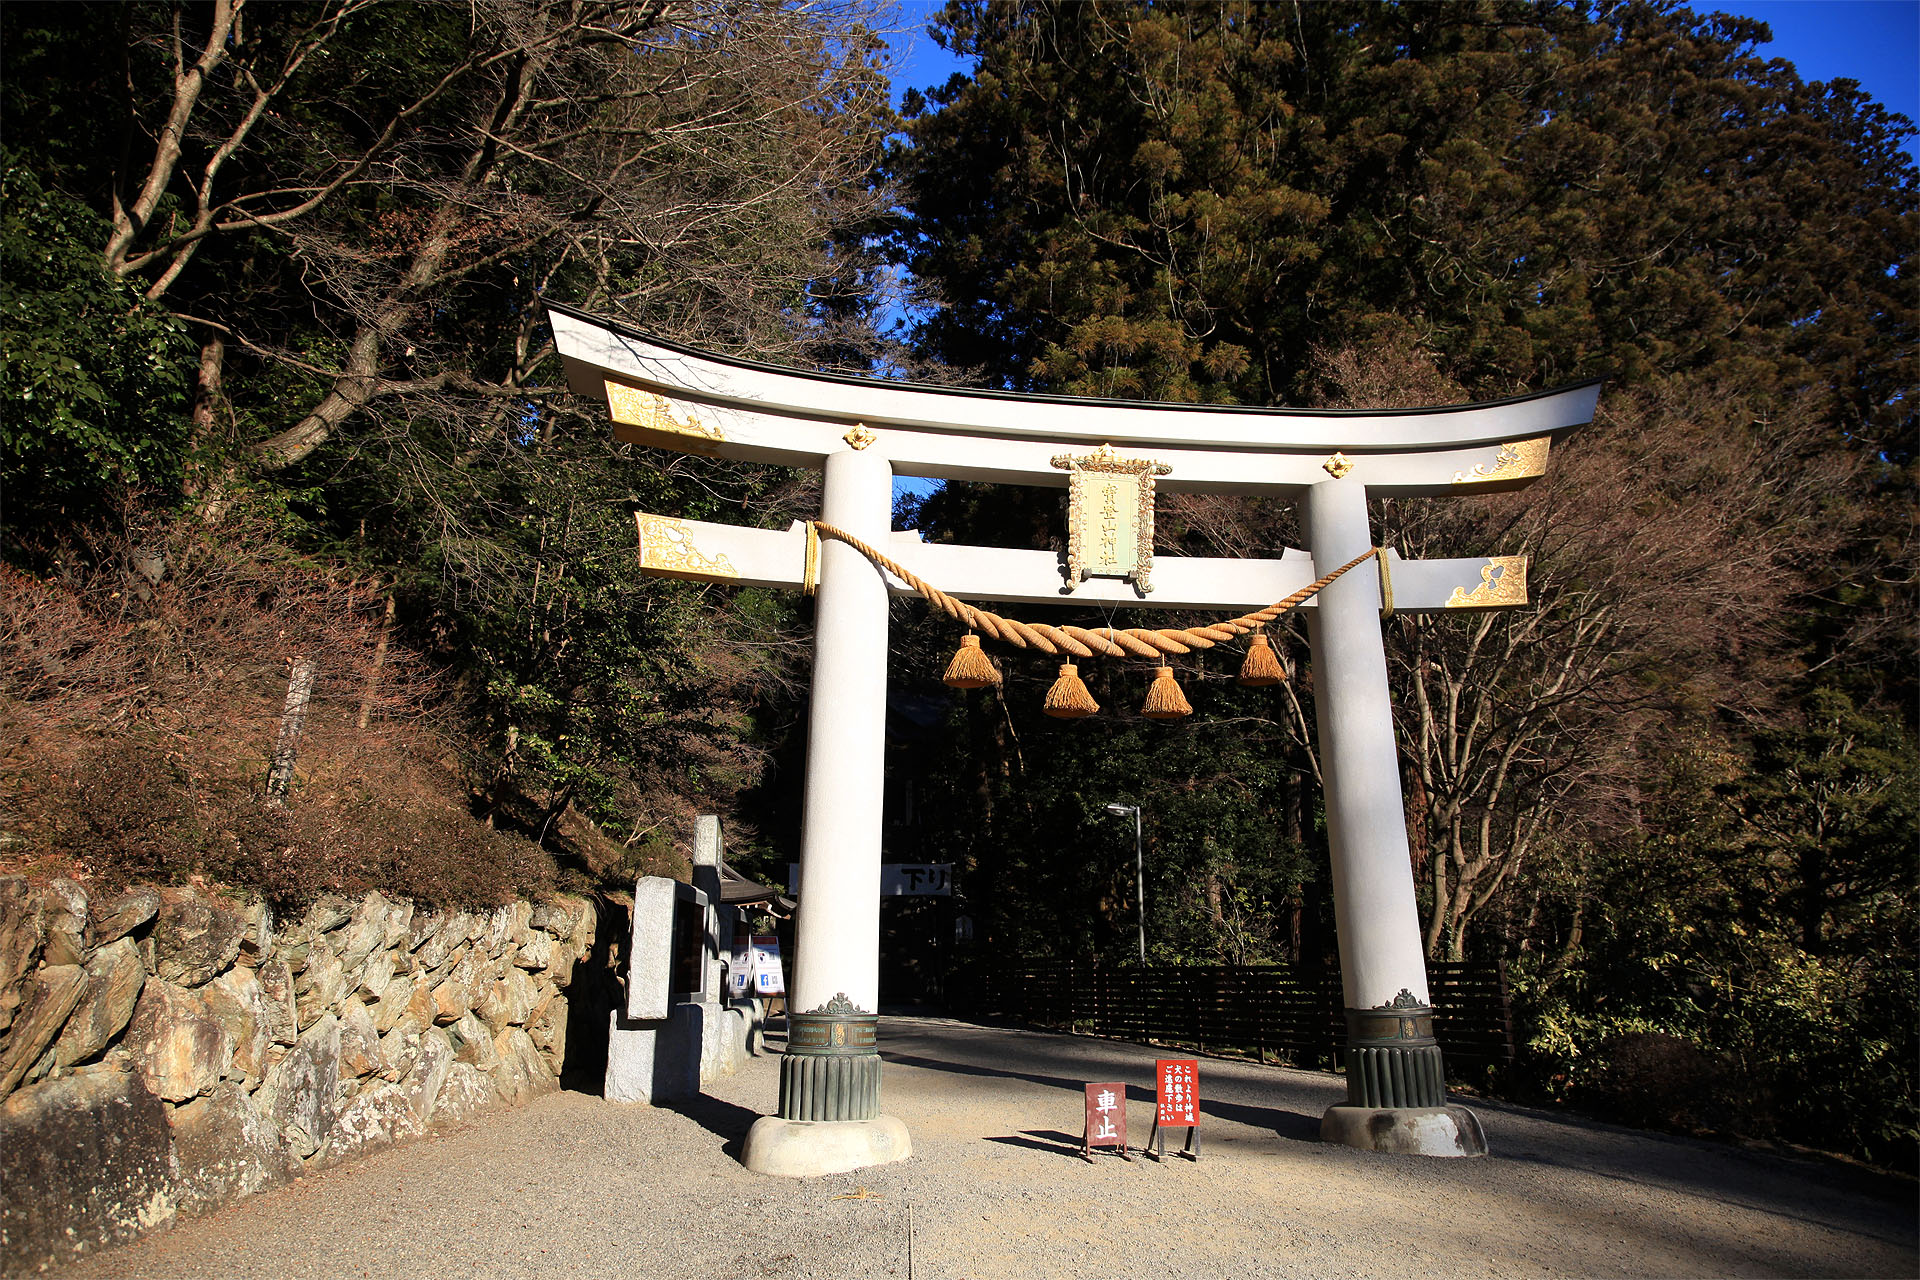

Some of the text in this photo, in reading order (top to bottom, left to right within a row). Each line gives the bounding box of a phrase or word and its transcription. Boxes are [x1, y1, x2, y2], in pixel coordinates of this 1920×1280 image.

[1096, 1089, 1118, 1140] 車止
[1164, 1065, 1175, 1121] ご遠慮下さい
[1174, 1064, 1184, 1112] 犬の散歩は
[1184, 1065, 1195, 1122] これより神域
